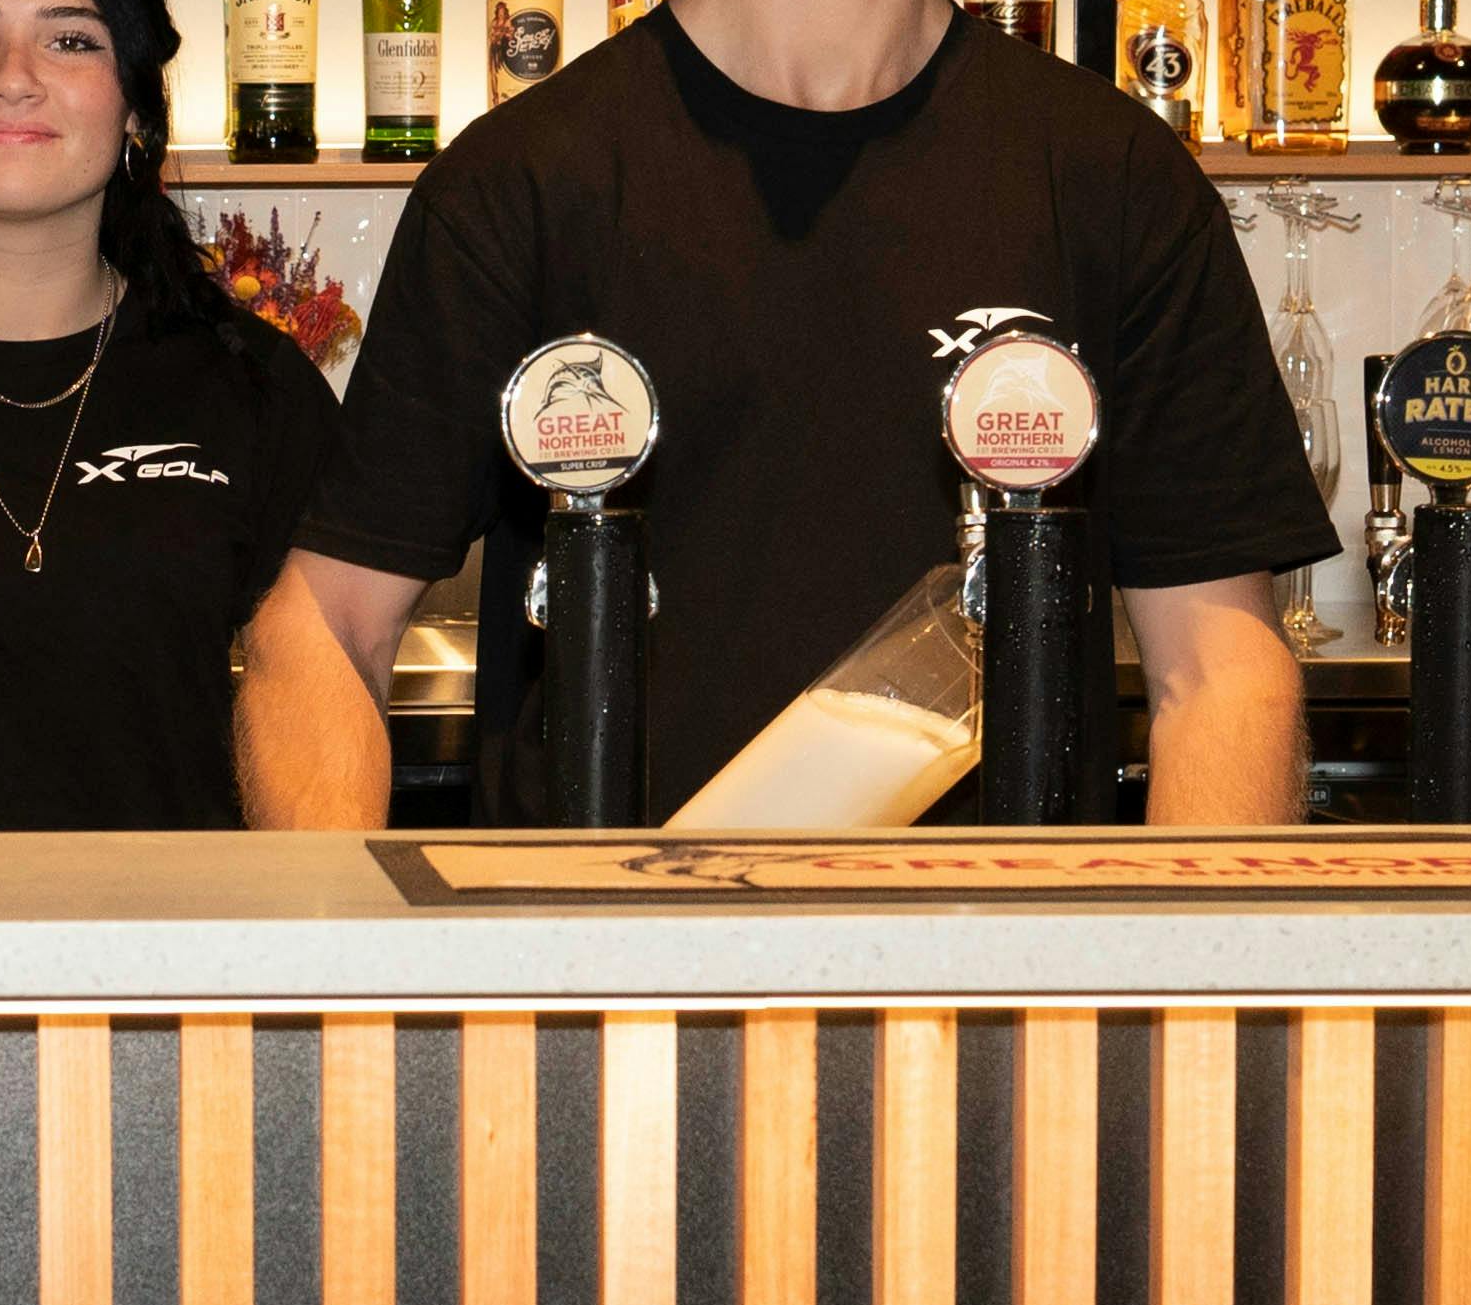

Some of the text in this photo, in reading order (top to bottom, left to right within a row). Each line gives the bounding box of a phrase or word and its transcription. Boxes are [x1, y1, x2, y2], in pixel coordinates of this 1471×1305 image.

[1145, 51, 1182, 79] 43
[927, 328, 982, 358] X
[537, 411, 624, 436] GREAT
[976, 411, 1064, 431] GREAT
[538, 432, 626, 451] NORTHERN
[976, 433, 1064, 446] NORTHERN
[553, 449, 598, 458] BREWING
[1432, 446, 1471, 456] LEMON
[560, 460, 608, 471] SUPER CRISP
[990, 459, 1028, 467] ORIGINAL
[1439, 463, 1463, 474] 4.5%
[75, 461, 229, 485] X GOLF
